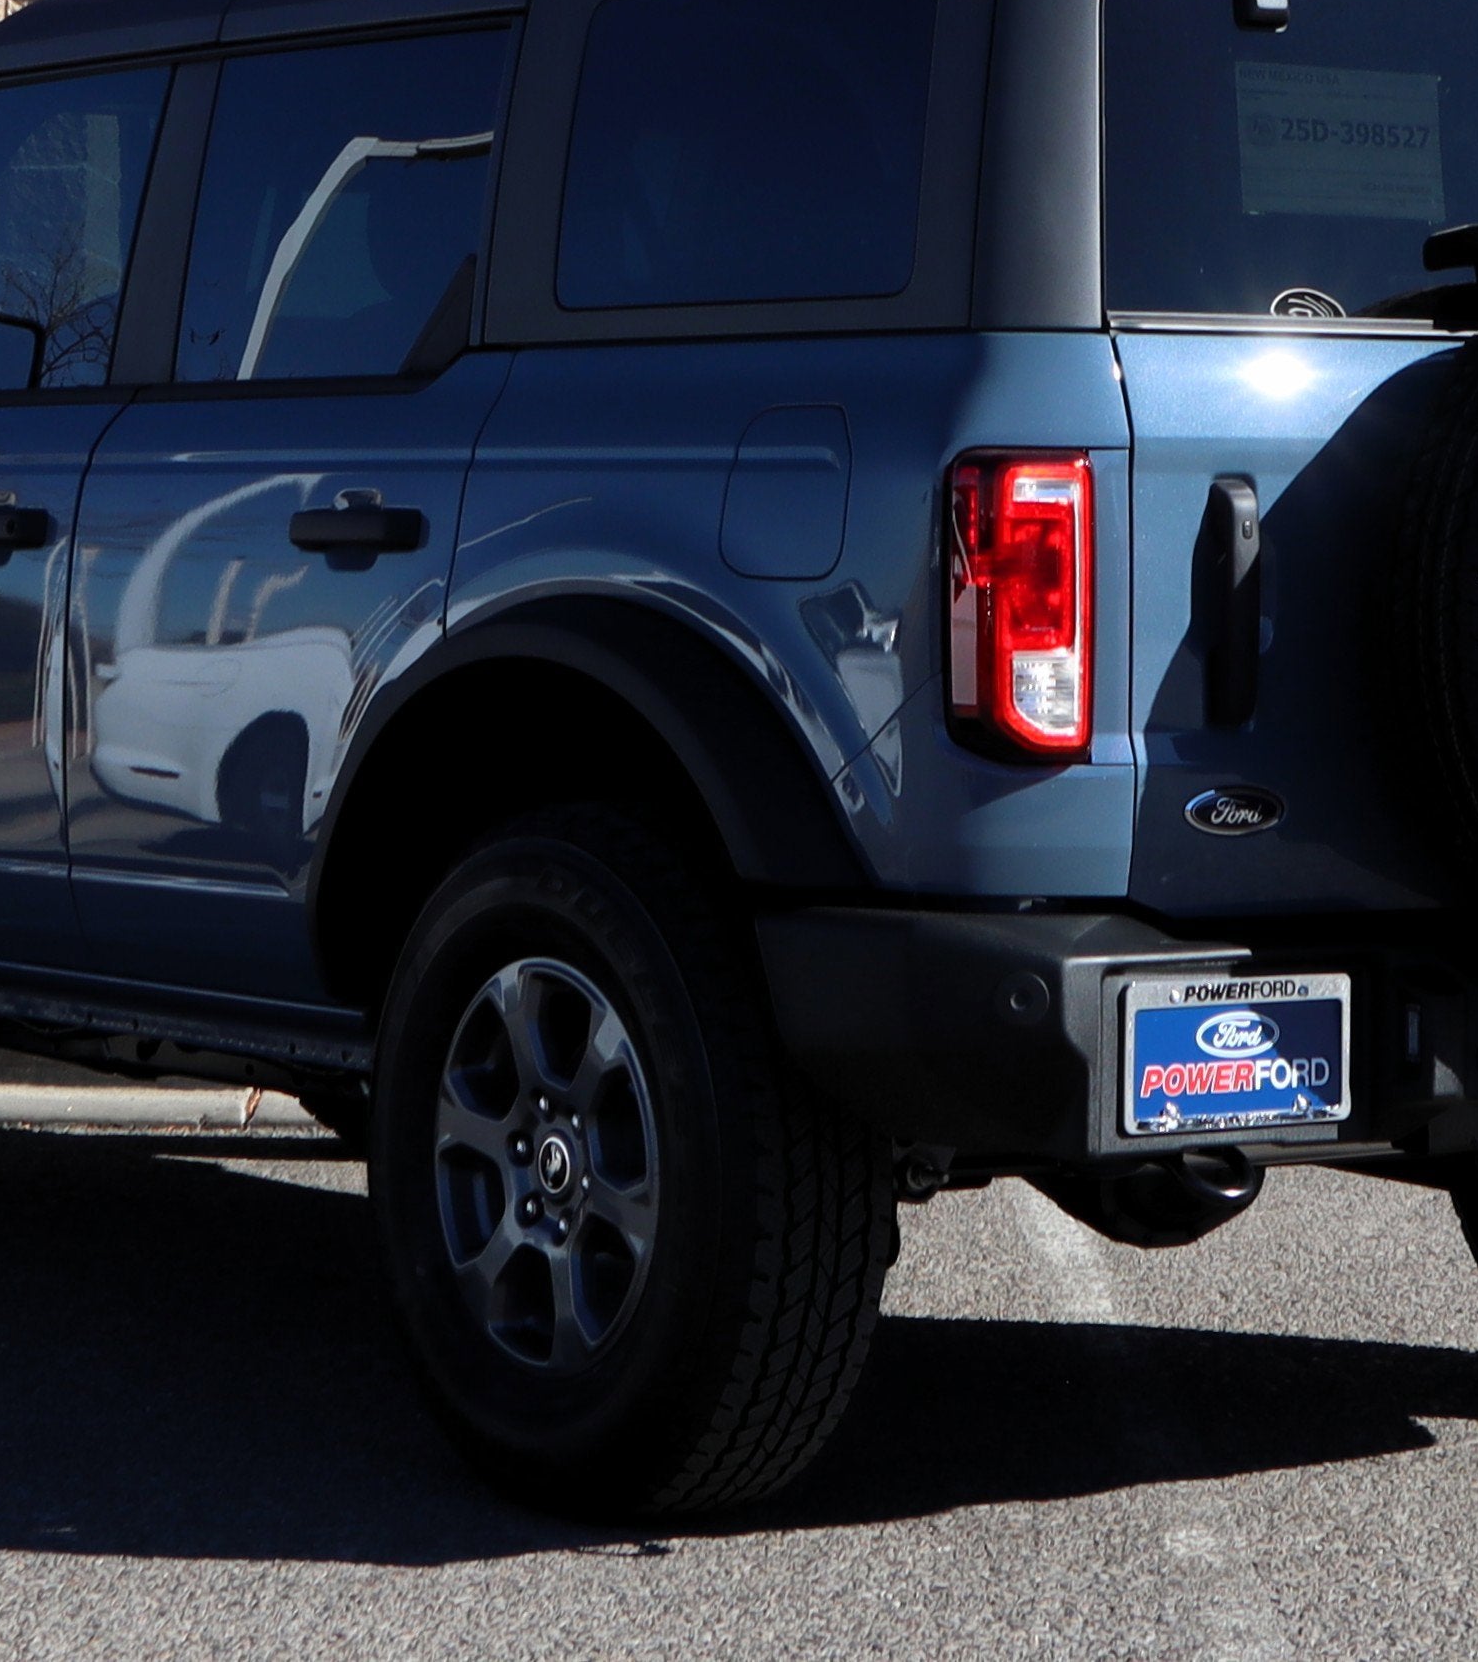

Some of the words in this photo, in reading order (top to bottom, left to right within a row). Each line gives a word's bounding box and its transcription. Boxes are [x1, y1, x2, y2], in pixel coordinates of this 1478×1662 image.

[1280, 118, 1431, 149] 25D-398527
[1211, 796, 1263, 825] Ford
[1183, 979, 1297, 1002] POWERFORD
[1211, 1019, 1263, 1048] Ford
[1140, 1057, 1330, 1098] POWERFORD
